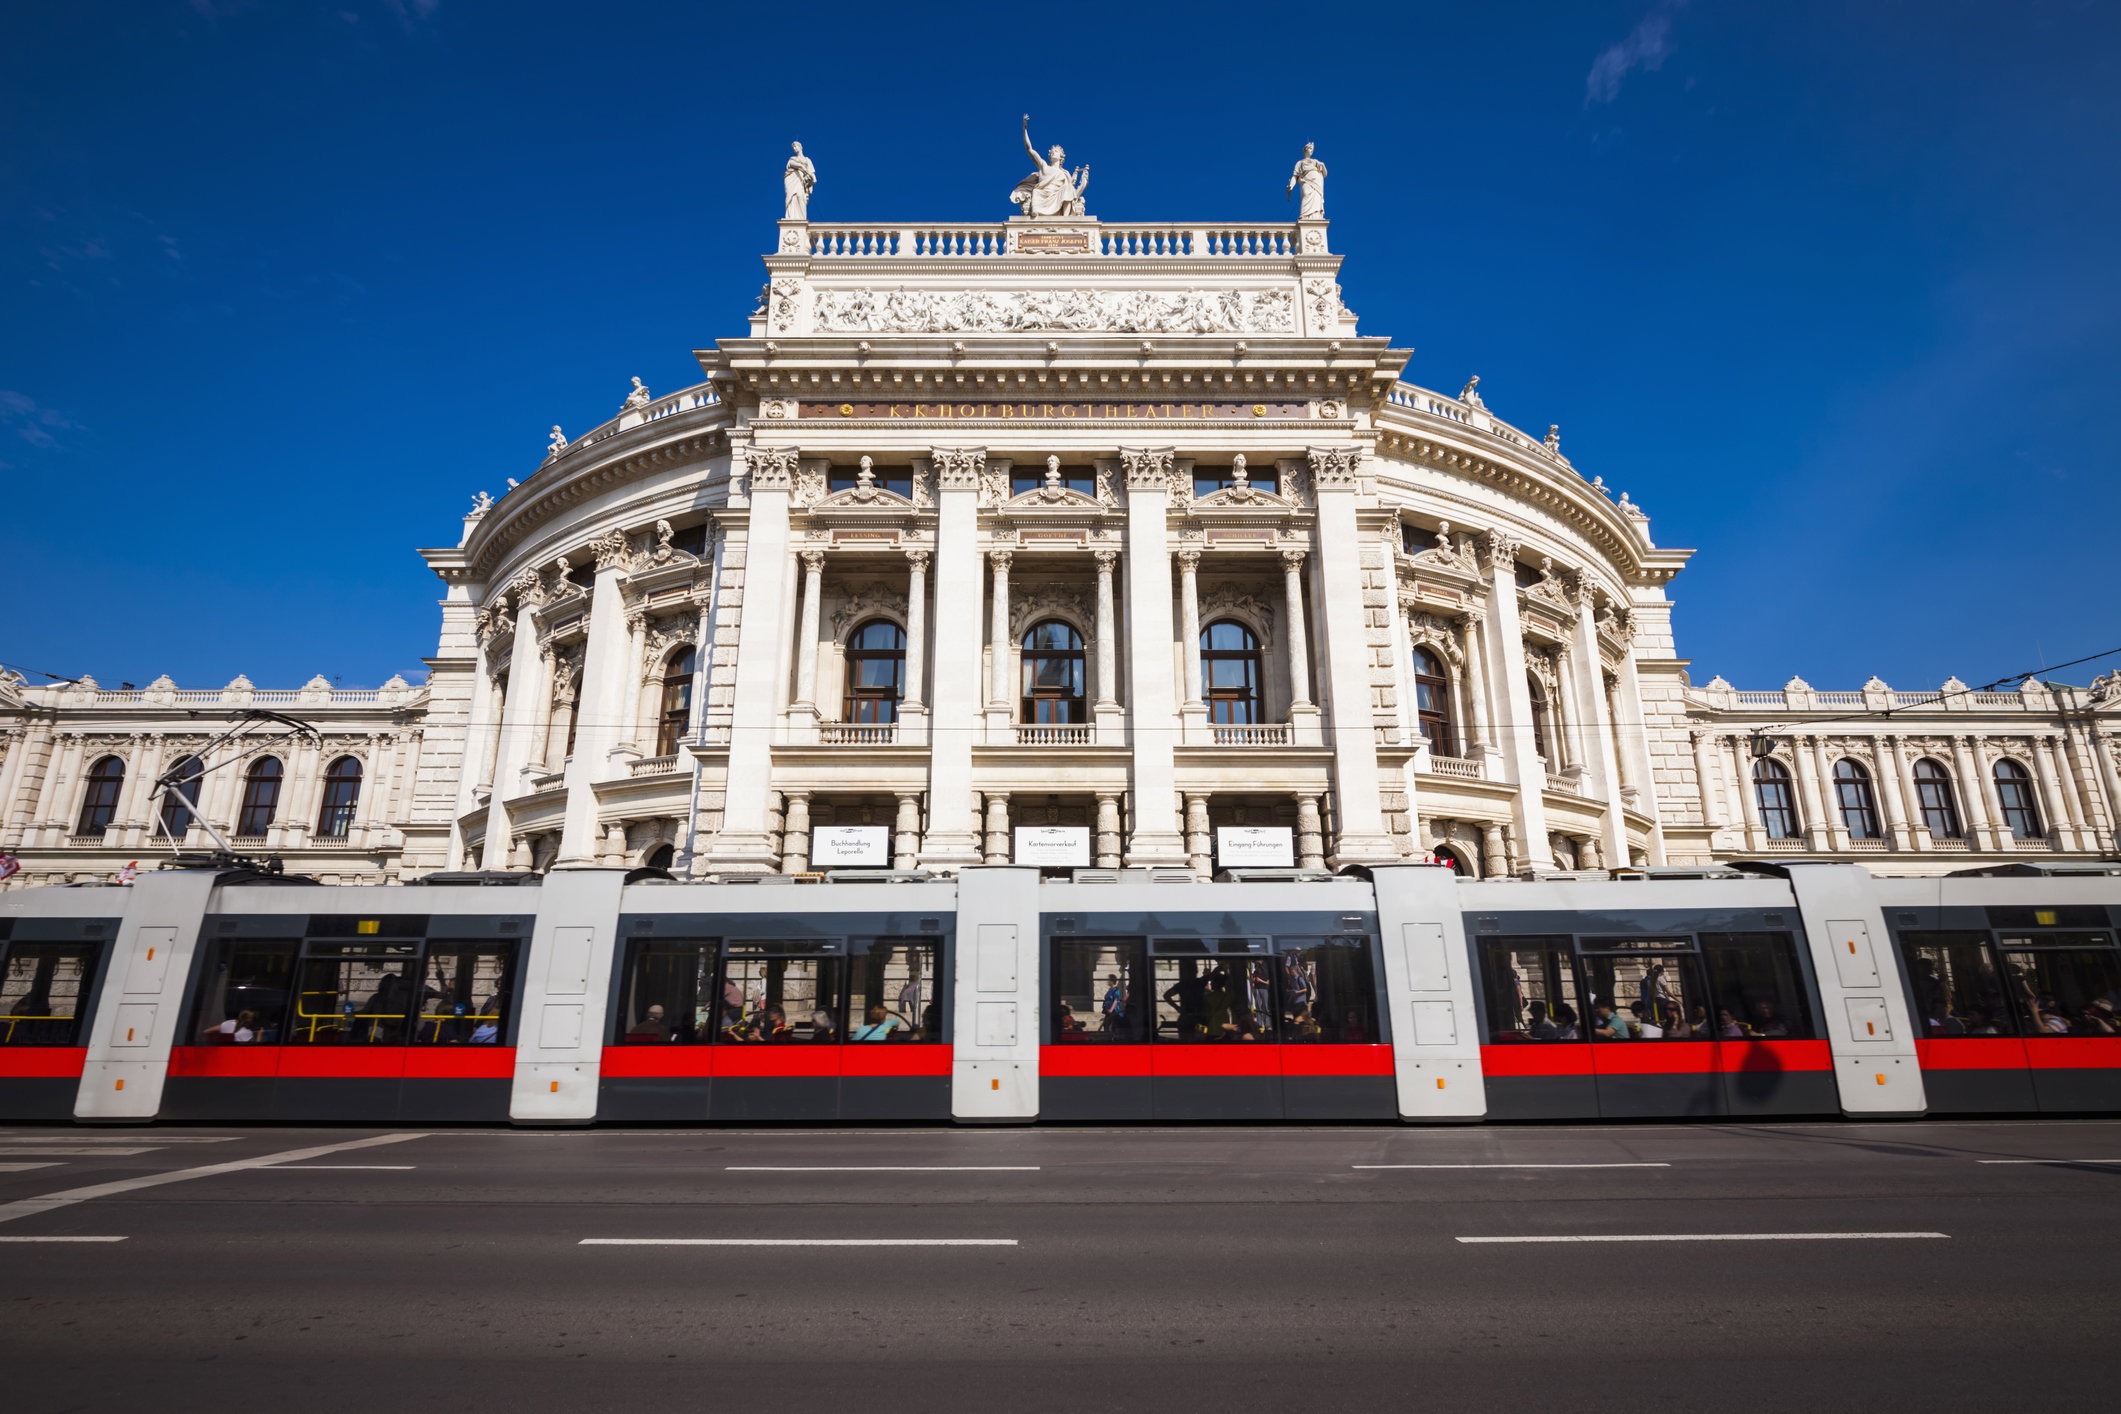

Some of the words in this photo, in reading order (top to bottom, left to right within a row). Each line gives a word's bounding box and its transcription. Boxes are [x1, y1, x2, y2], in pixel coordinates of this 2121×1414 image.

[831, 840, 871, 848] Buchhandlung
[1228, 841, 1252, 849] Eingang
[1252, 841, 1283, 849] Führungen
[837, 848, 864, 856] Leporello
